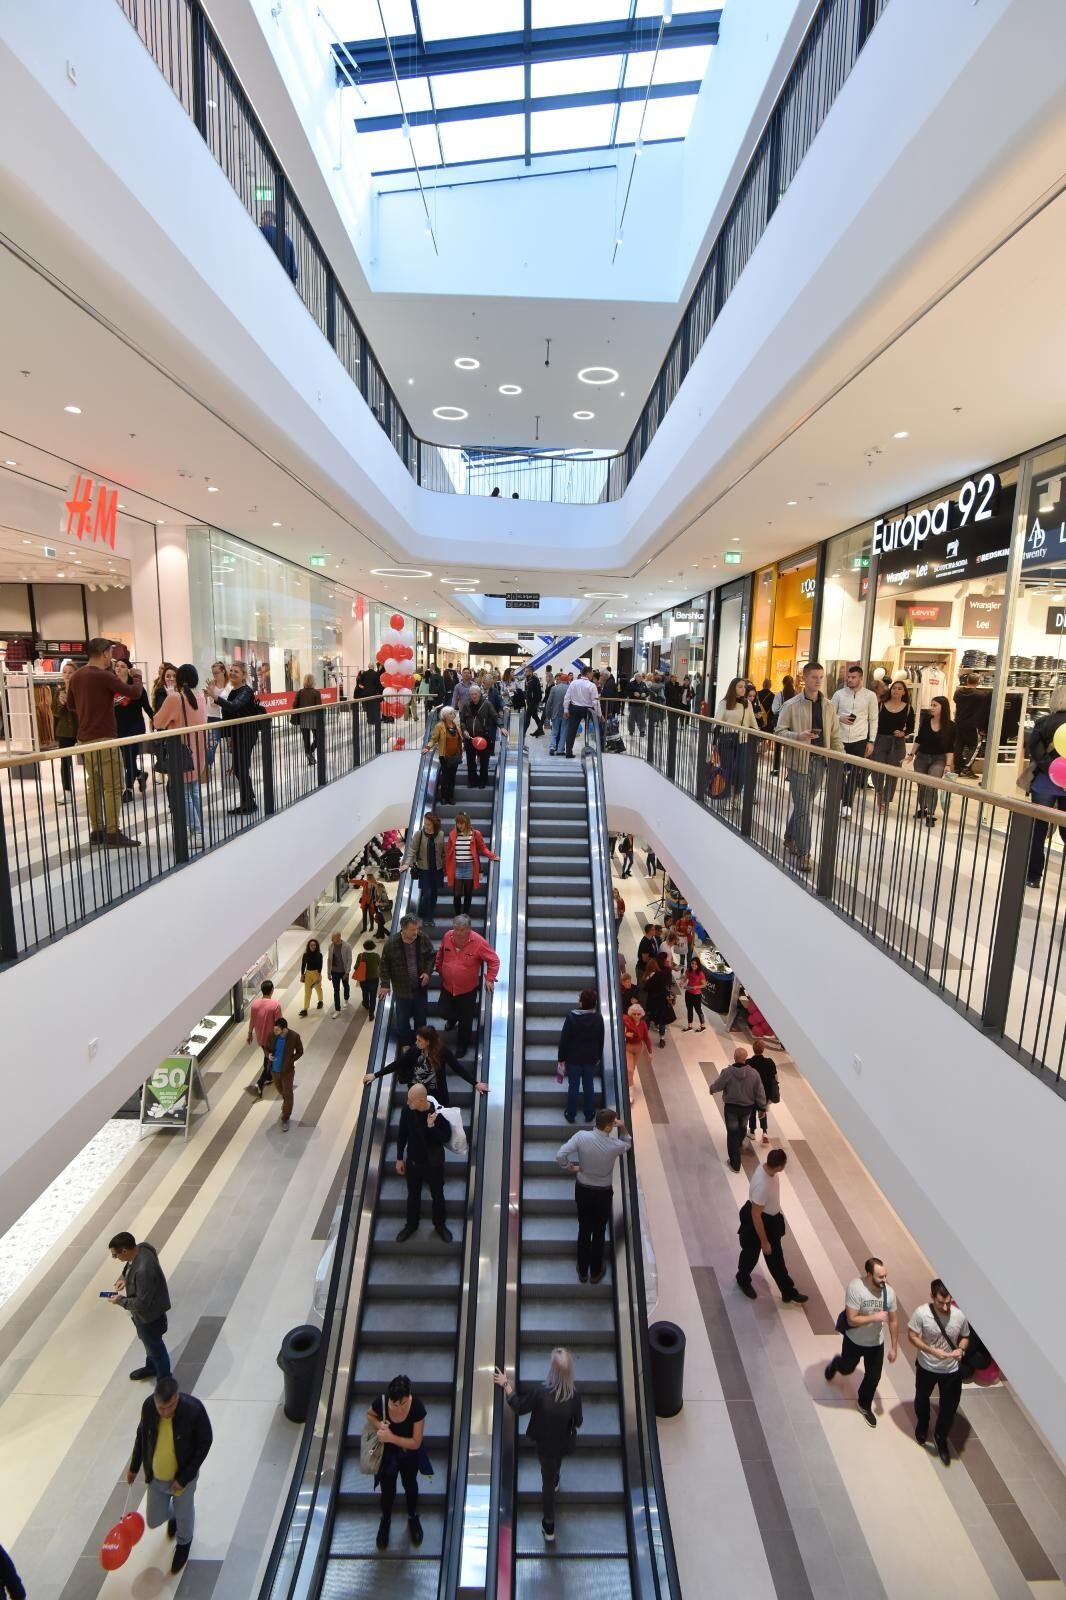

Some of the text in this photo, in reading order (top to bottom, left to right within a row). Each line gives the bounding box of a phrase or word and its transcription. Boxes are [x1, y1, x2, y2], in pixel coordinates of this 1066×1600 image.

[65, 474, 118, 551] H&M
[872, 473, 996, 555] Europa 92
[886, 568, 911, 586] Wrangler
[915, 563, 929, 578] Lee
[969, 600, 1001, 612] Wrangler
[676, 611, 704, 620] Bershka
[976, 620, 989, 629] Lee
